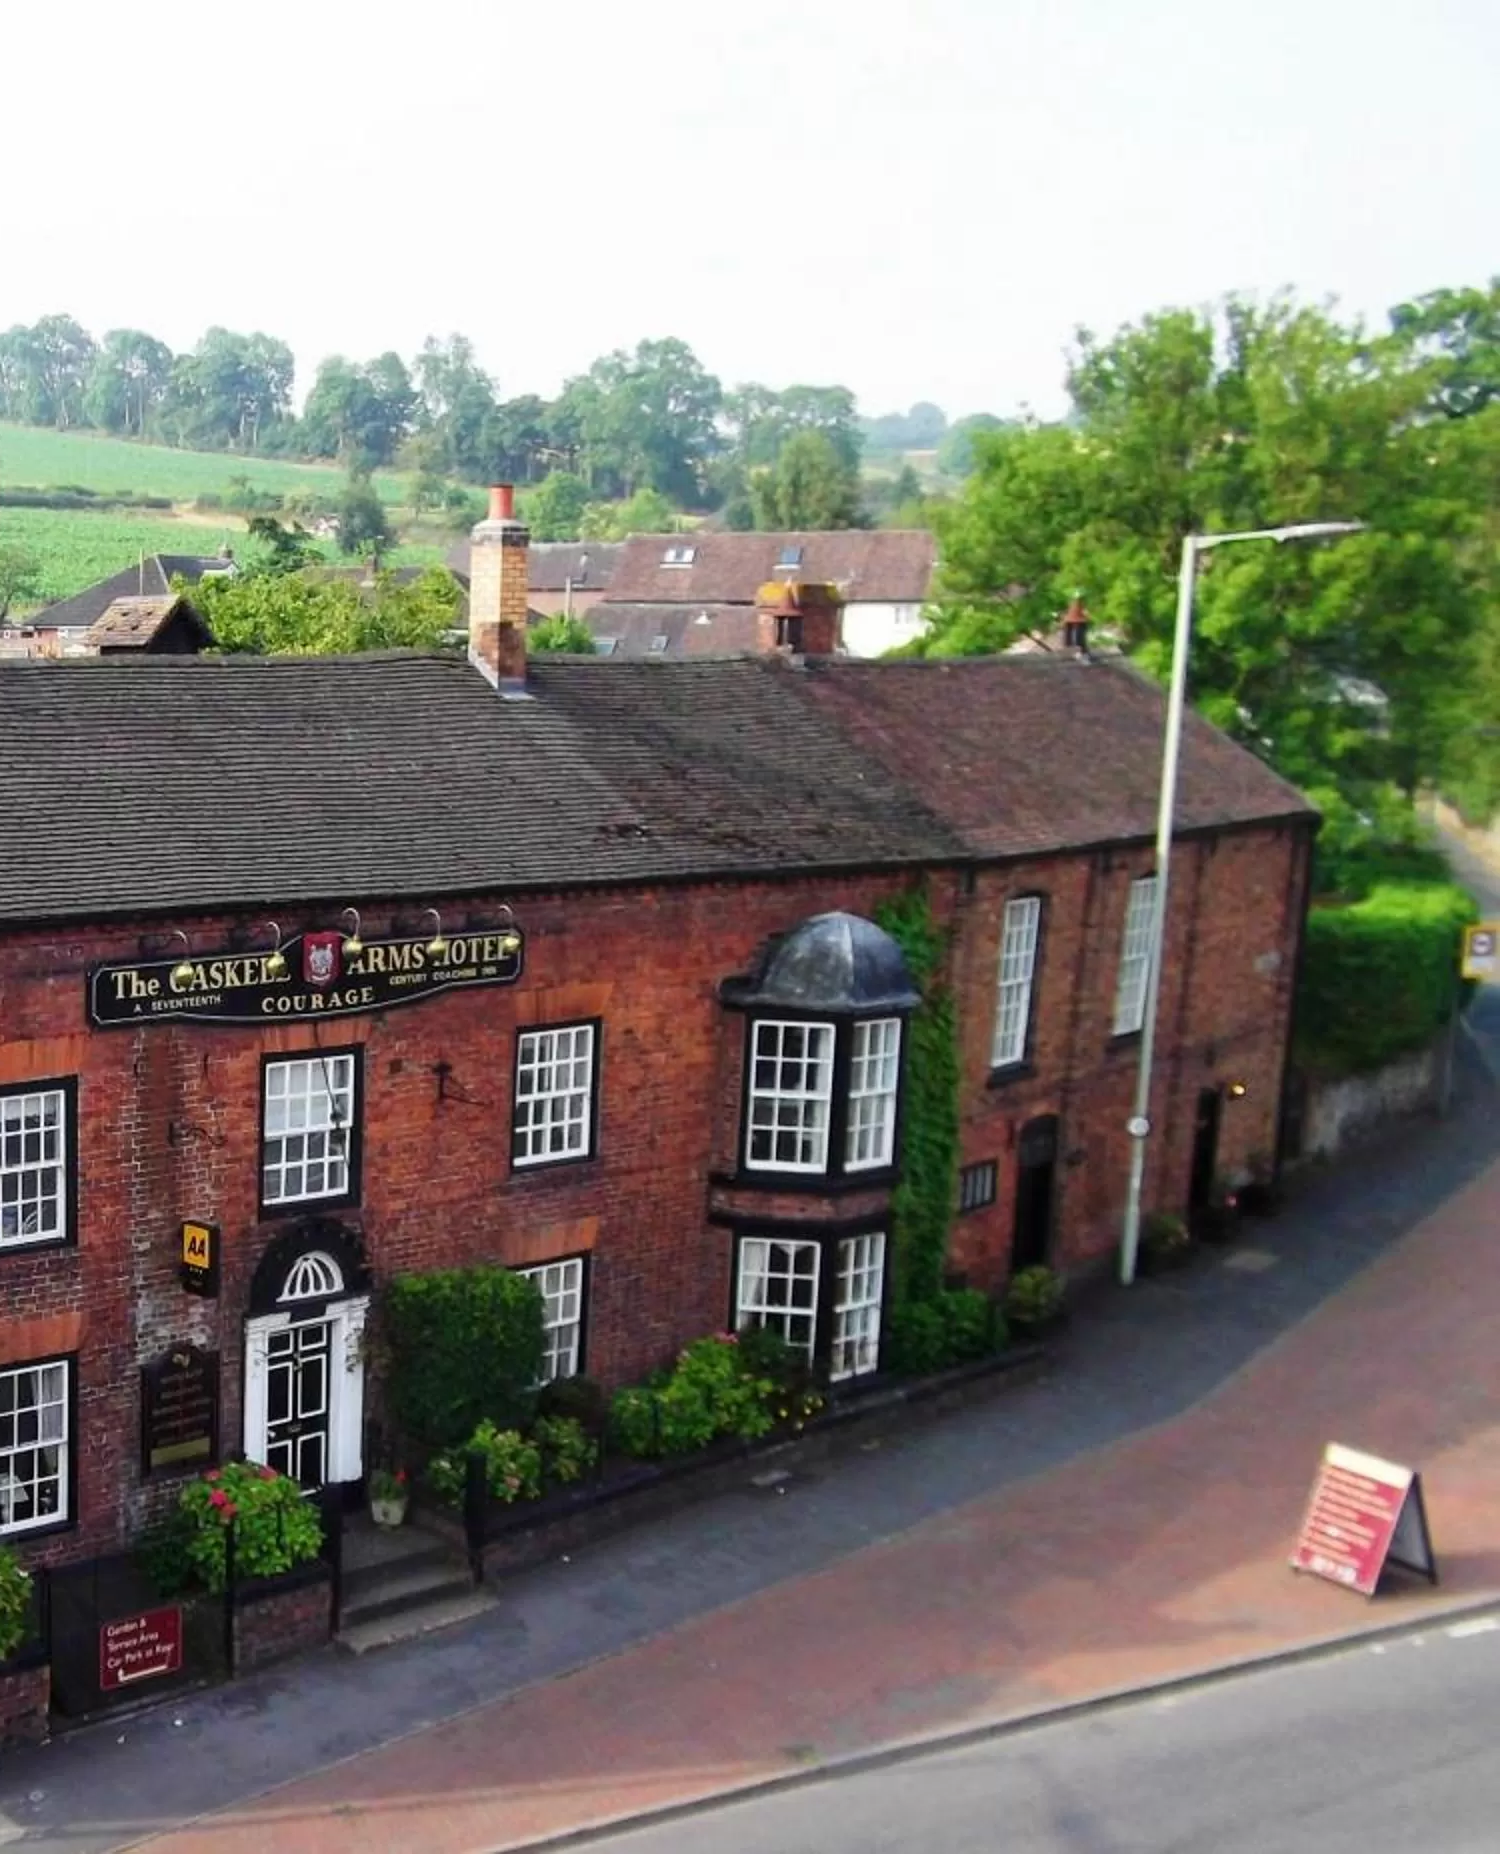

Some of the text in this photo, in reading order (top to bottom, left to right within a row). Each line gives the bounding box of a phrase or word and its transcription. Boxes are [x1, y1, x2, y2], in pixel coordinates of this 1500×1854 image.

[111, 970, 161, 1000] The
[169, 956, 292, 994] ASKEL
[133, 1003, 143, 1013] A
[261, 986, 374, 1013] COURAGE
[188, 1236, 206, 1258] AA
